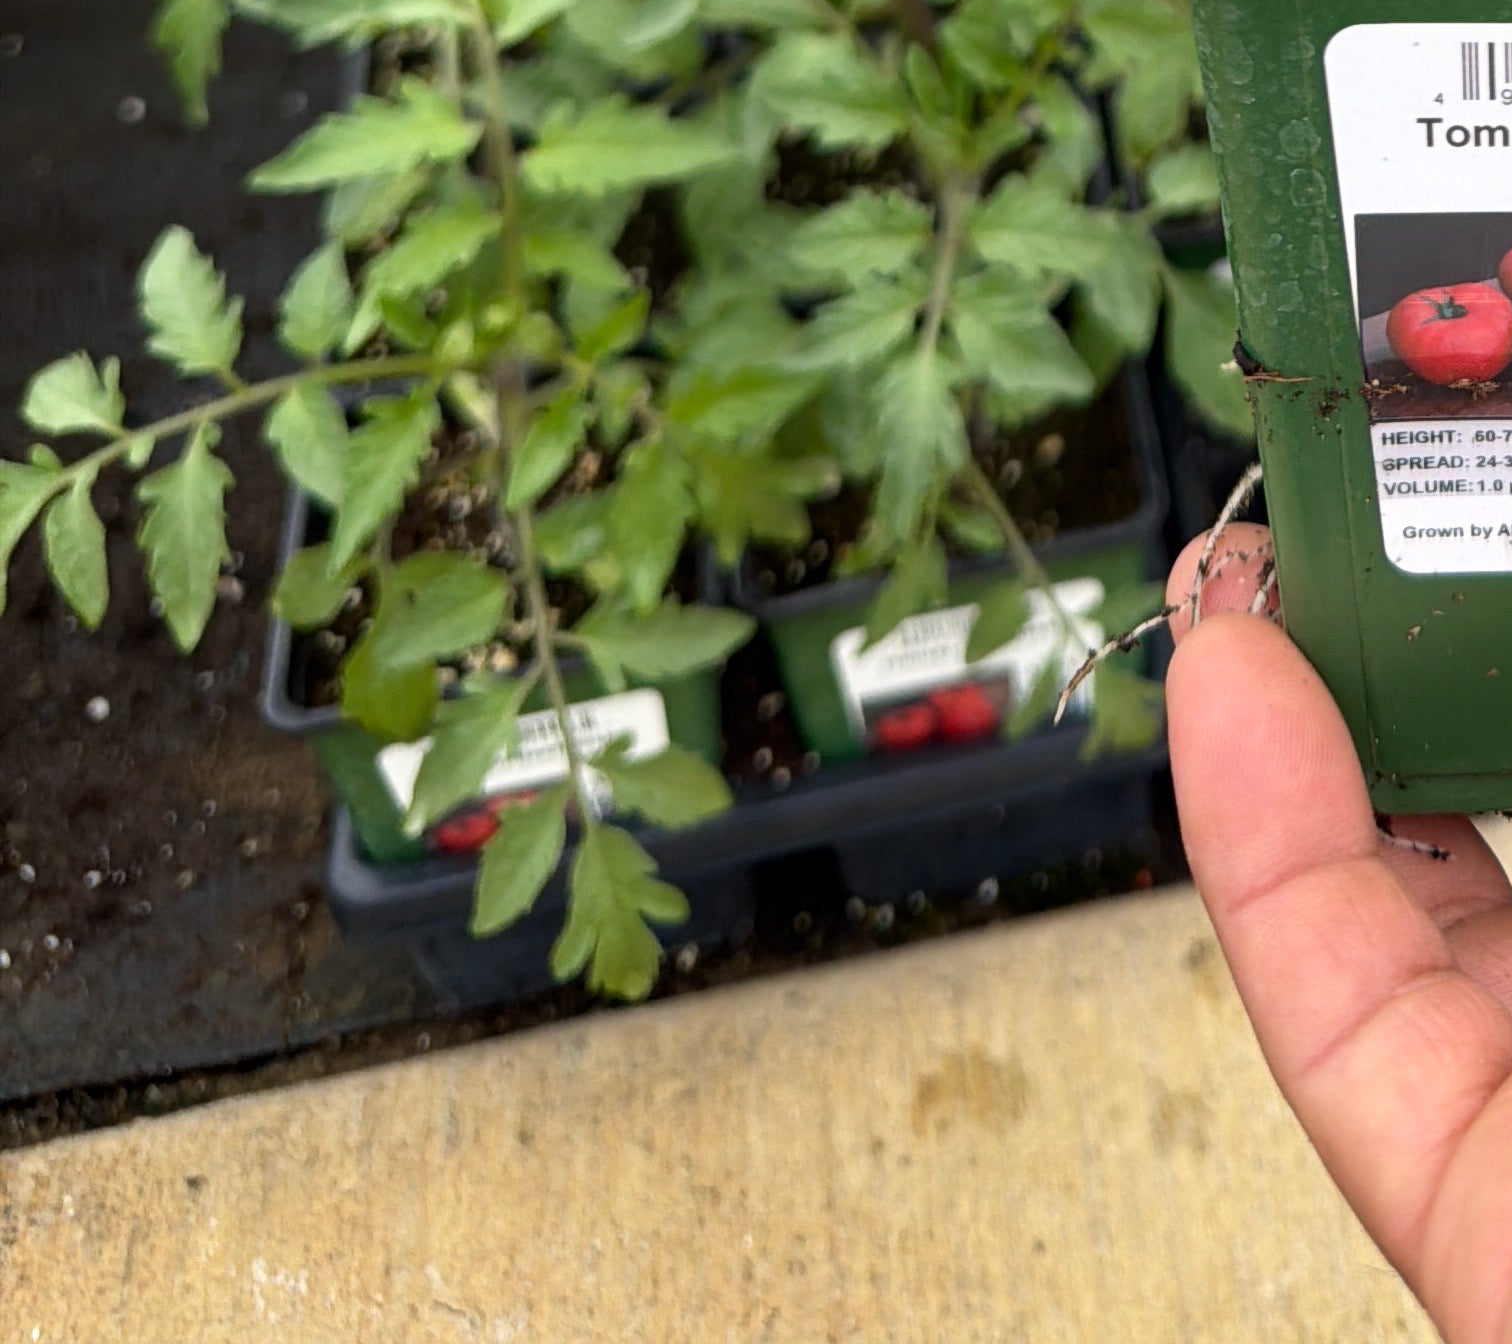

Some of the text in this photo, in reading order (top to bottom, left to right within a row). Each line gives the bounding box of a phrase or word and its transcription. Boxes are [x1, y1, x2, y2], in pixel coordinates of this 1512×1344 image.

[1433, 92, 1445, 105] 4
[1382, 429, 1463, 445] HEIGHT:
[1383, 455, 1470, 471] SPREAD:
[1384, 479, 1474, 495] VOLUME:
[1479, 478, 1504, 492] 1.0
[1402, 524, 1464, 539] Grown
[1471, 524, 1493, 539] by
